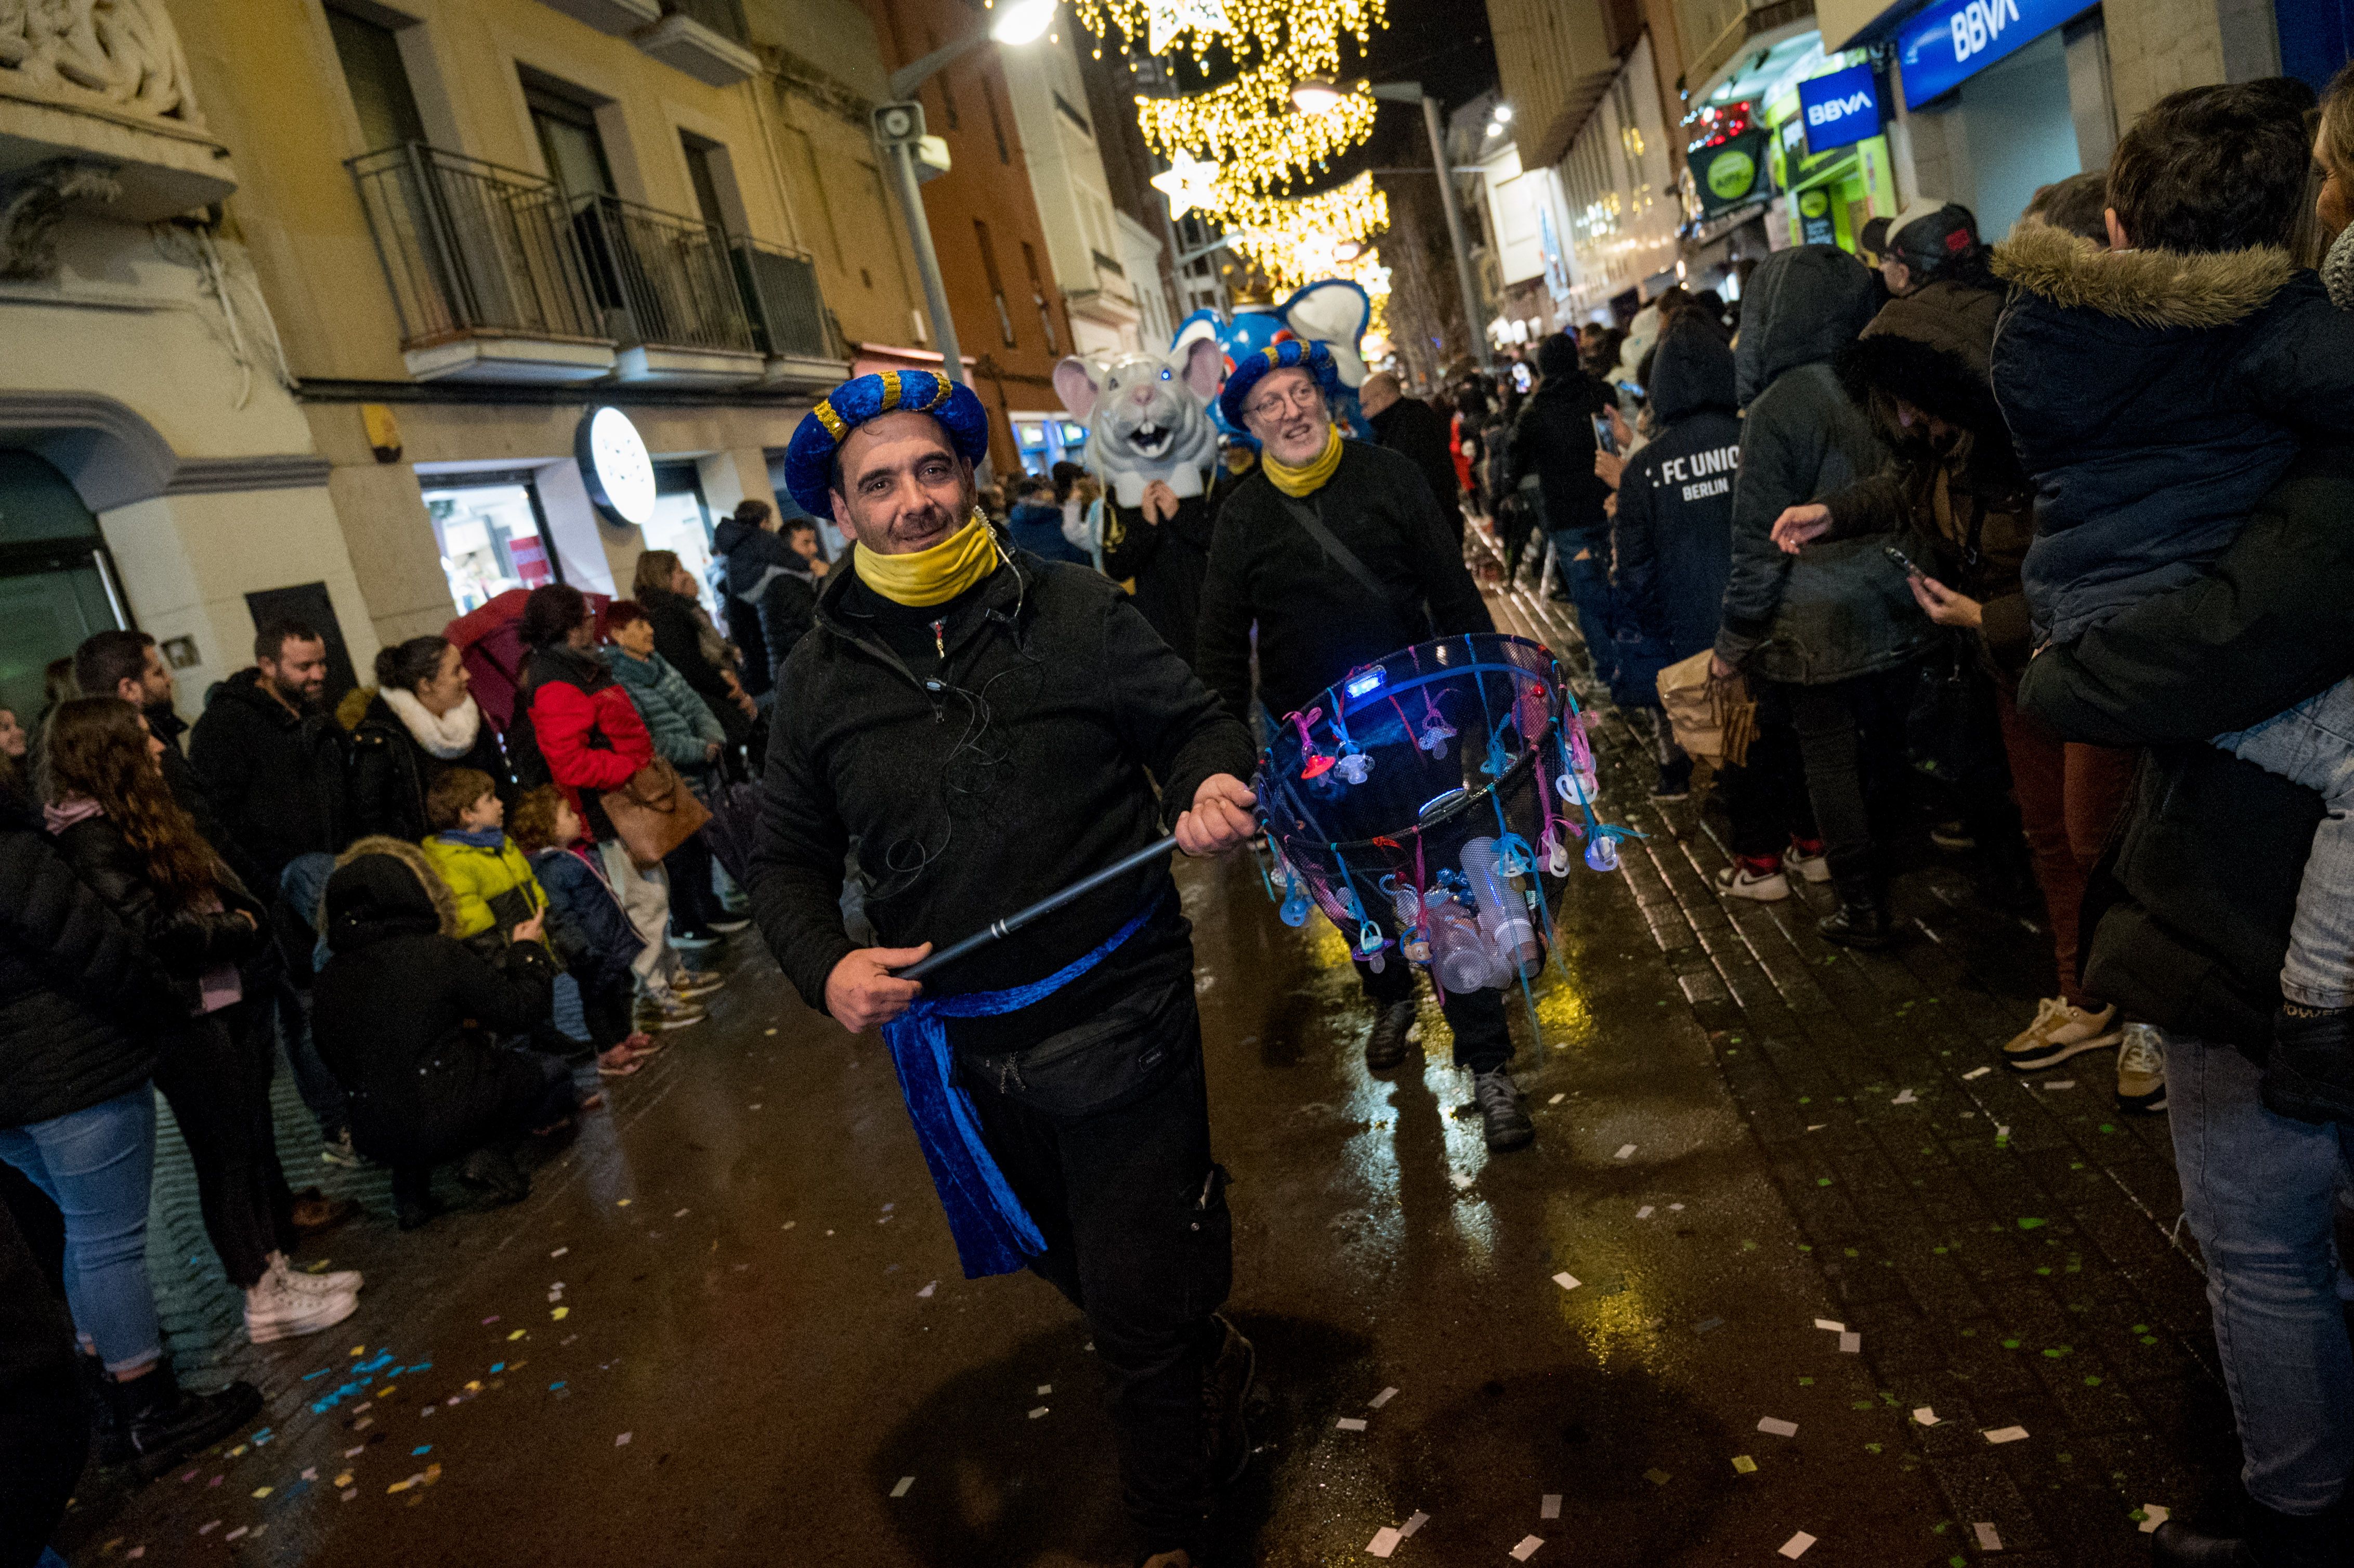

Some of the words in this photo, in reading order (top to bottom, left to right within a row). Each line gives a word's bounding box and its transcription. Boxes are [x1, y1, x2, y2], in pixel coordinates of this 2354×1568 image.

[1951, 0, 2020, 62] BBVA
[1808, 90, 1872, 126] BBVA
[1682, 477, 1730, 501] BERLIN
